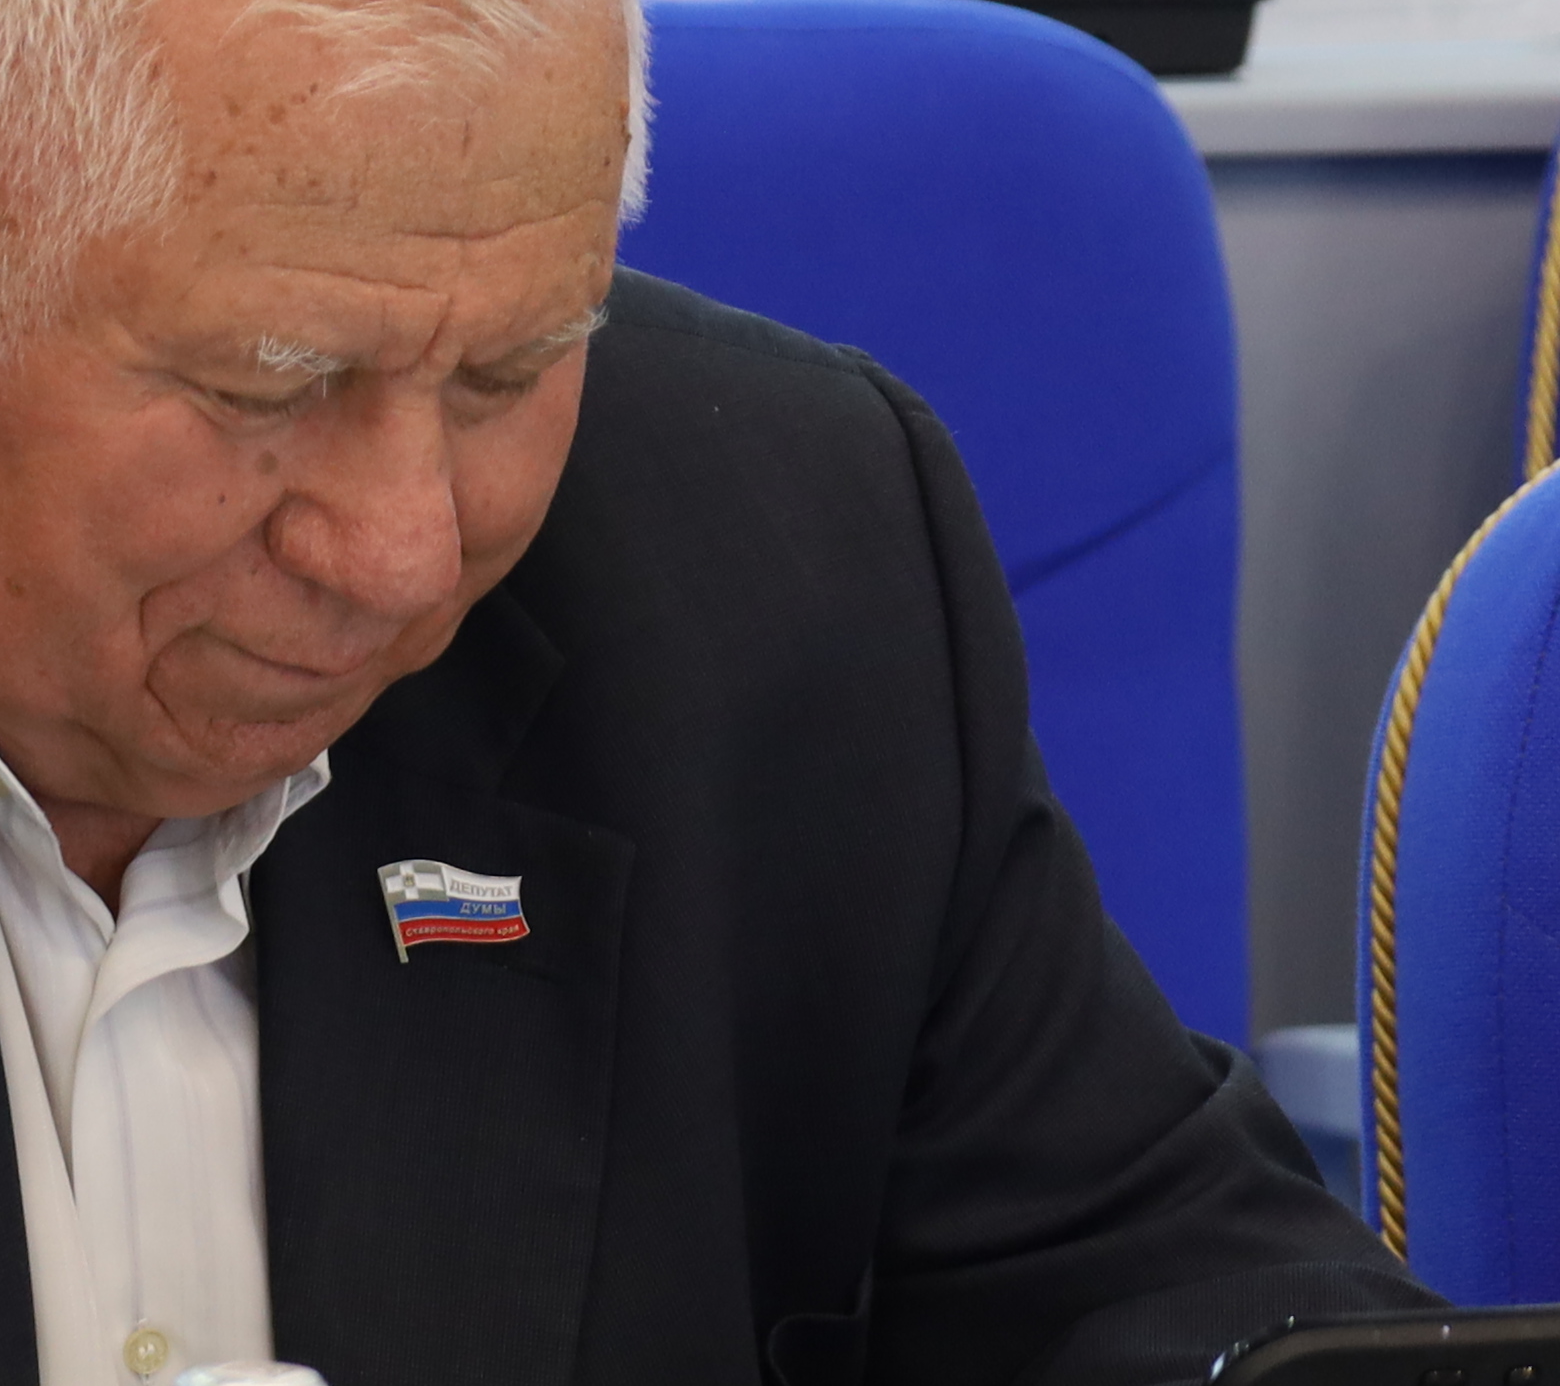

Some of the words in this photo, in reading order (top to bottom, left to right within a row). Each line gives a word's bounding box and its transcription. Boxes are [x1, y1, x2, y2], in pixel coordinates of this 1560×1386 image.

[449, 878, 513, 897] ДЕПУТАТ
[460, 902, 507, 915] ДУМЫ
[405, 924, 495, 937] Ставропольского
[497, 924, 519, 936] края
